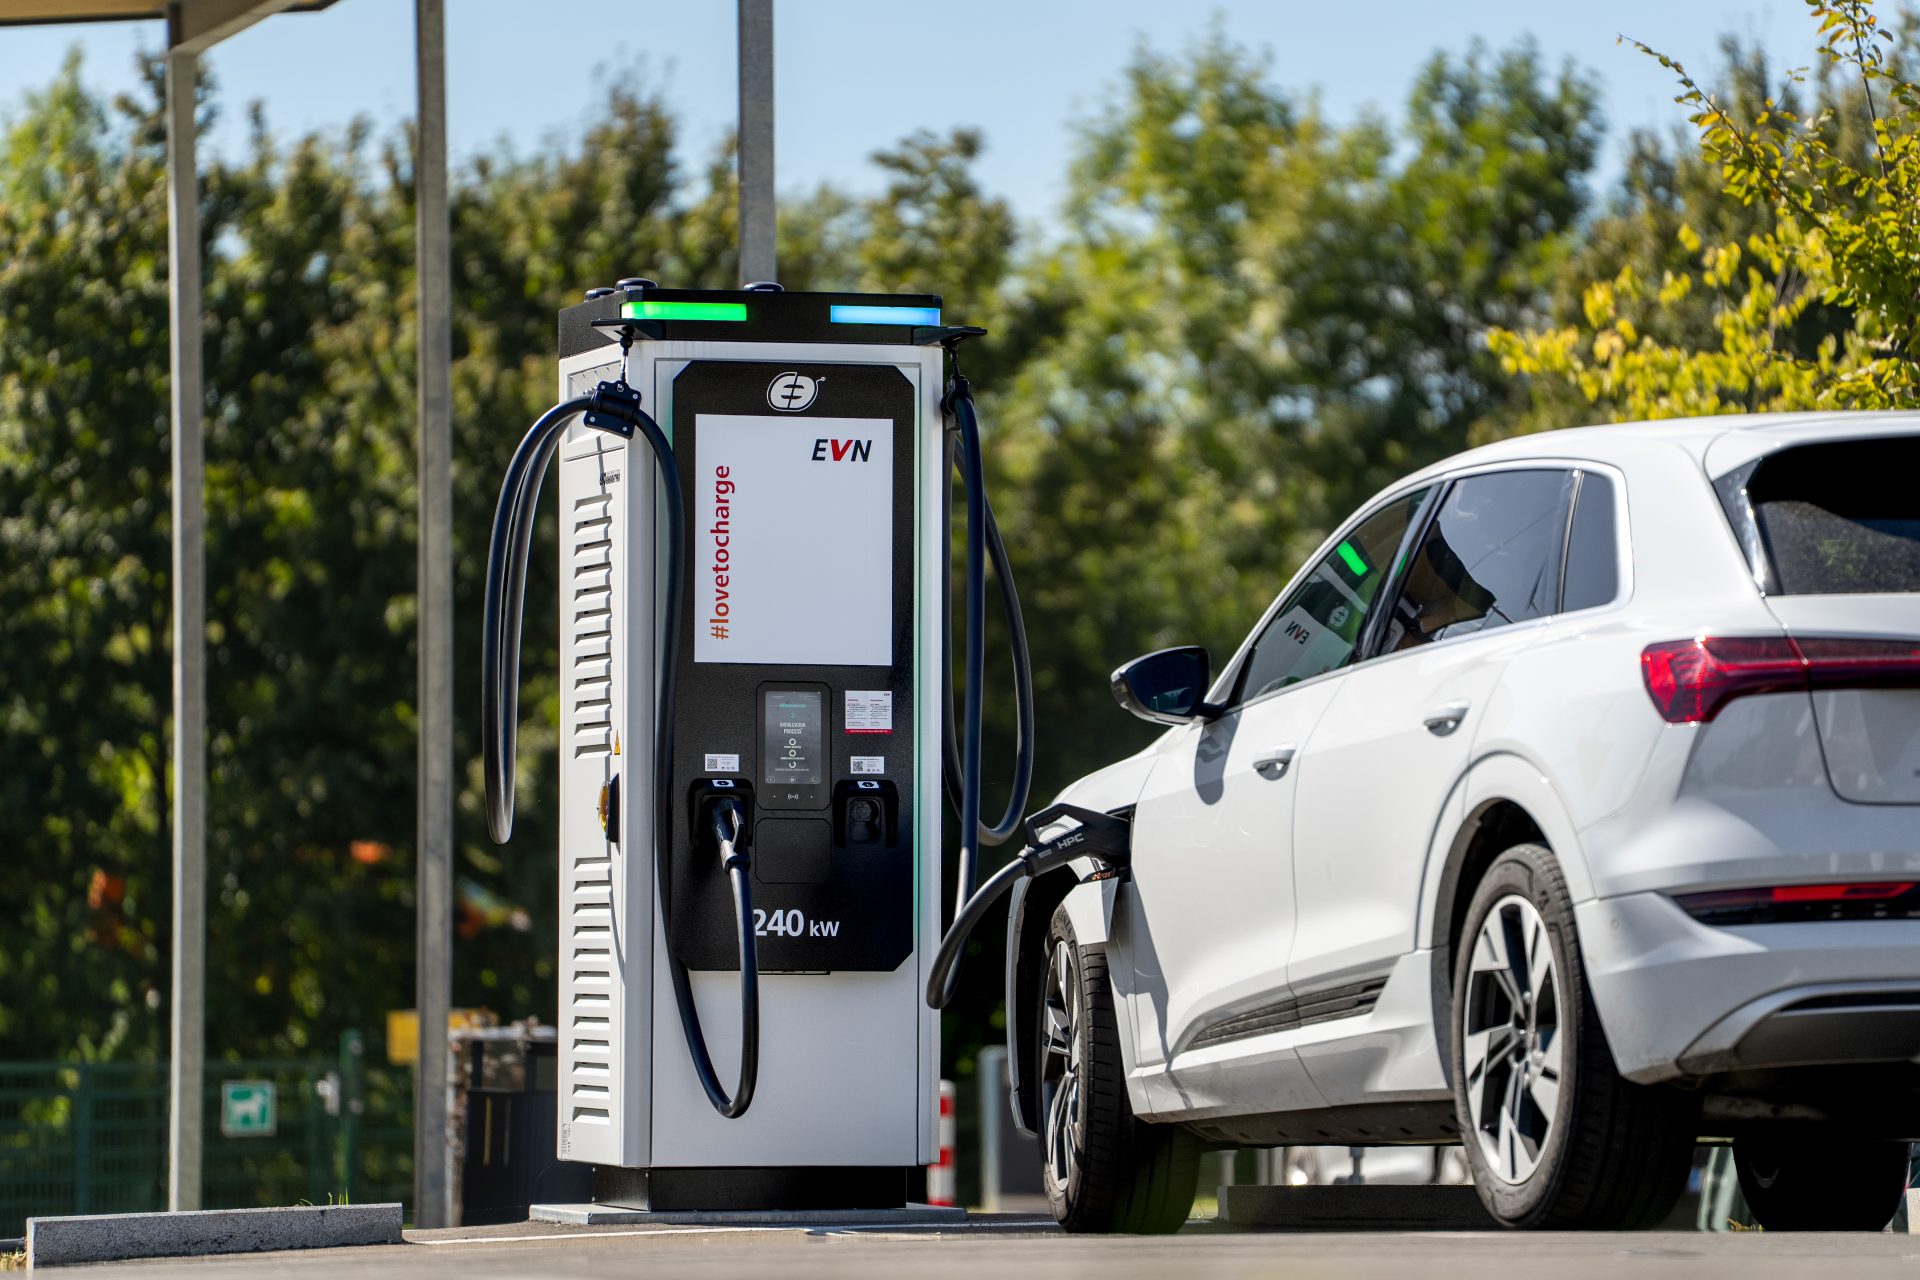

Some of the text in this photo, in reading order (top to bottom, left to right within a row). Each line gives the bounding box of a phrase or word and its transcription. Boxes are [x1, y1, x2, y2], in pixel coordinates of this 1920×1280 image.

[811, 438, 872, 462] EVN
[709, 465, 735, 640] #lovetocharge
[1057, 833, 1085, 849] HPC
[753, 908, 840, 937] 240 kW
